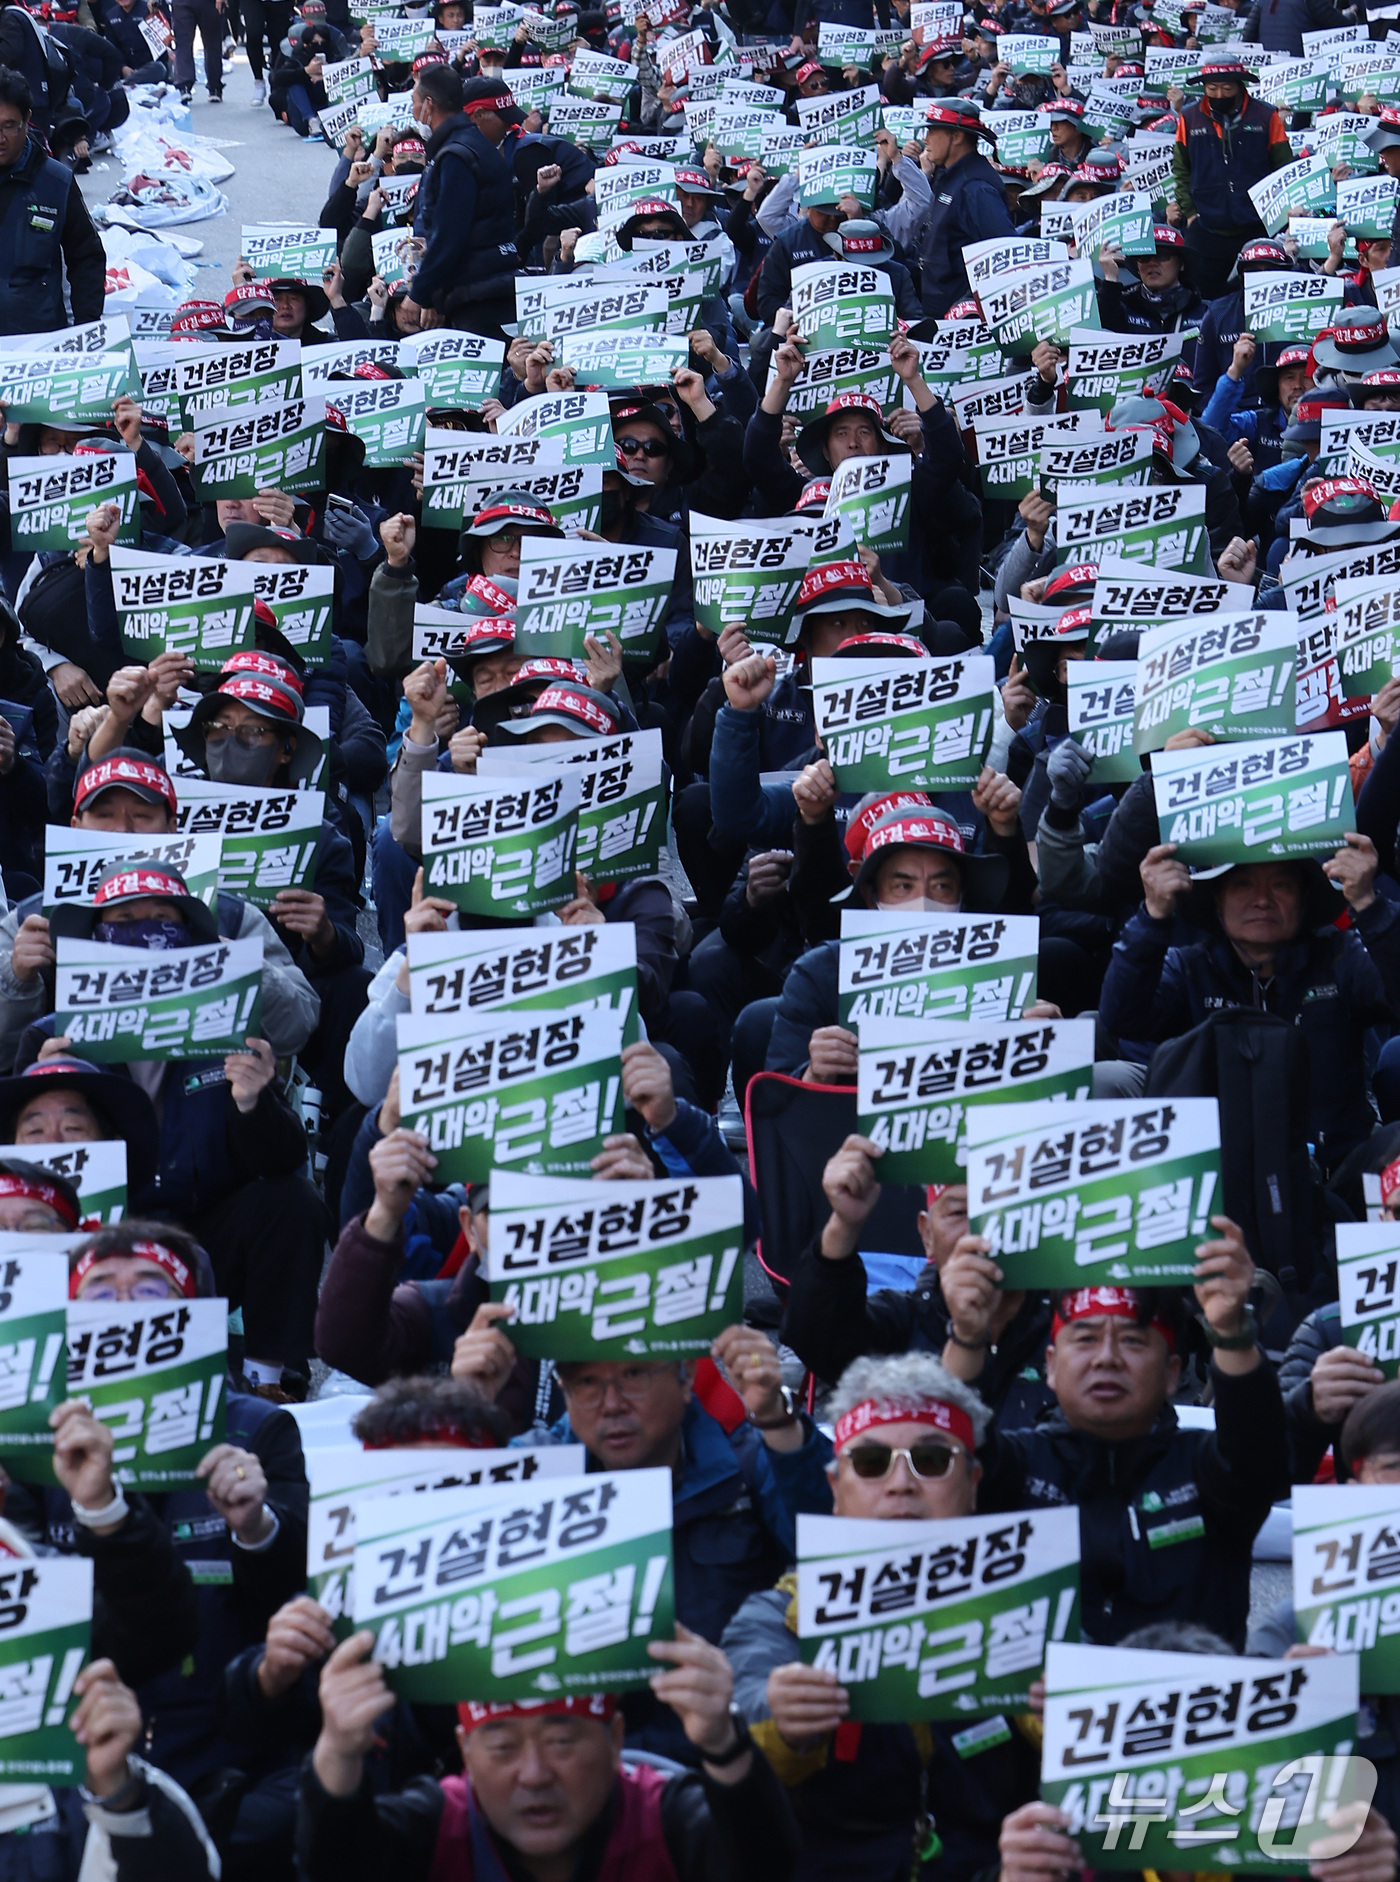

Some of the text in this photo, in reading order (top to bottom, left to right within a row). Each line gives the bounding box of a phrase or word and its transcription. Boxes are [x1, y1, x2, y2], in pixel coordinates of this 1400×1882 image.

[377, 19, 425, 40] 건설현장
[821, 30, 868, 45] 건설현장
[922, 16, 961, 43] 쟁취!
[1001, 38, 1050, 56] 건설현장
[575, 60, 630, 77] 건설현장
[1261, 60, 1314, 94] 건설현장
[1343, 56, 1397, 80] 건설현장
[553, 105, 611, 121] 건설현장
[727, 89, 777, 103] 건설현장
[805, 89, 867, 131] 건설현장
[1089, 97, 1135, 119] 건설현장
[719, 114, 776, 131] 건설현장
[1317, 116, 1370, 147] 건설현장
[600, 168, 662, 198] 건설현장
[803, 151, 867, 181] 건설현장
[1257, 159, 1312, 213] 건설현장
[1077, 194, 1136, 241] 건설현장
[247, 229, 322, 255] 건설현장
[236, 287, 257, 300] 단결
[796, 270, 879, 311] 건설현장
[989, 265, 1072, 323] 건설현장
[1250, 278, 1328, 311] 건설현장
[179, 317, 199, 332] 단결
[551, 290, 649, 335] 건설현장
[417, 338, 487, 365] 설현장
[570, 334, 669, 358] 건설현장
[1075, 336, 1168, 373] 건설현장
[2, 354, 107, 383] 건설현장
[183, 343, 280, 391] 건설현장
[203, 400, 307, 458] 건설현장
[1046, 433, 1139, 475] 건설현장
[17, 457, 118, 509] 건설현장
[1311, 481, 1336, 504] 단결
[1065, 489, 1182, 543] 건설현장
[694, 535, 793, 572] 건설현장
[120, 563, 228, 607] 건설현장
[526, 551, 654, 600] 건설현장
[842, 565, 870, 584] 투쟁
[1068, 565, 1099, 582] 단결
[1100, 584, 1229, 617] 건설현장
[1141, 614, 1268, 697] 건설현장
[821, 661, 965, 730] 건설현장
[83, 761, 171, 796] 단결 투쟁
[1168, 739, 1316, 809] 건설현장
[430, 779, 563, 847] 건설현장
[861, 797, 894, 830] 단결
[871, 821, 963, 851] 단결 투쟁
[103, 872, 140, 897] 단결
[850, 920, 1007, 986] 건설현장
[68, 946, 230, 1007] 건설현장
[425, 930, 599, 1014] 건설현장
[411, 1016, 585, 1105] 건설현장
[871, 1027, 1056, 1106] 건설현장
[981, 1105, 1177, 1205] 건설현장
[502, 1184, 700, 1272] 건설현장
[67, 1306, 191, 1383] 설현장
[374, 1483, 618, 1605] 건설현장
[814, 1519, 1035, 1627] 건설현장
[1061, 1666, 1309, 1768] 건설현장
